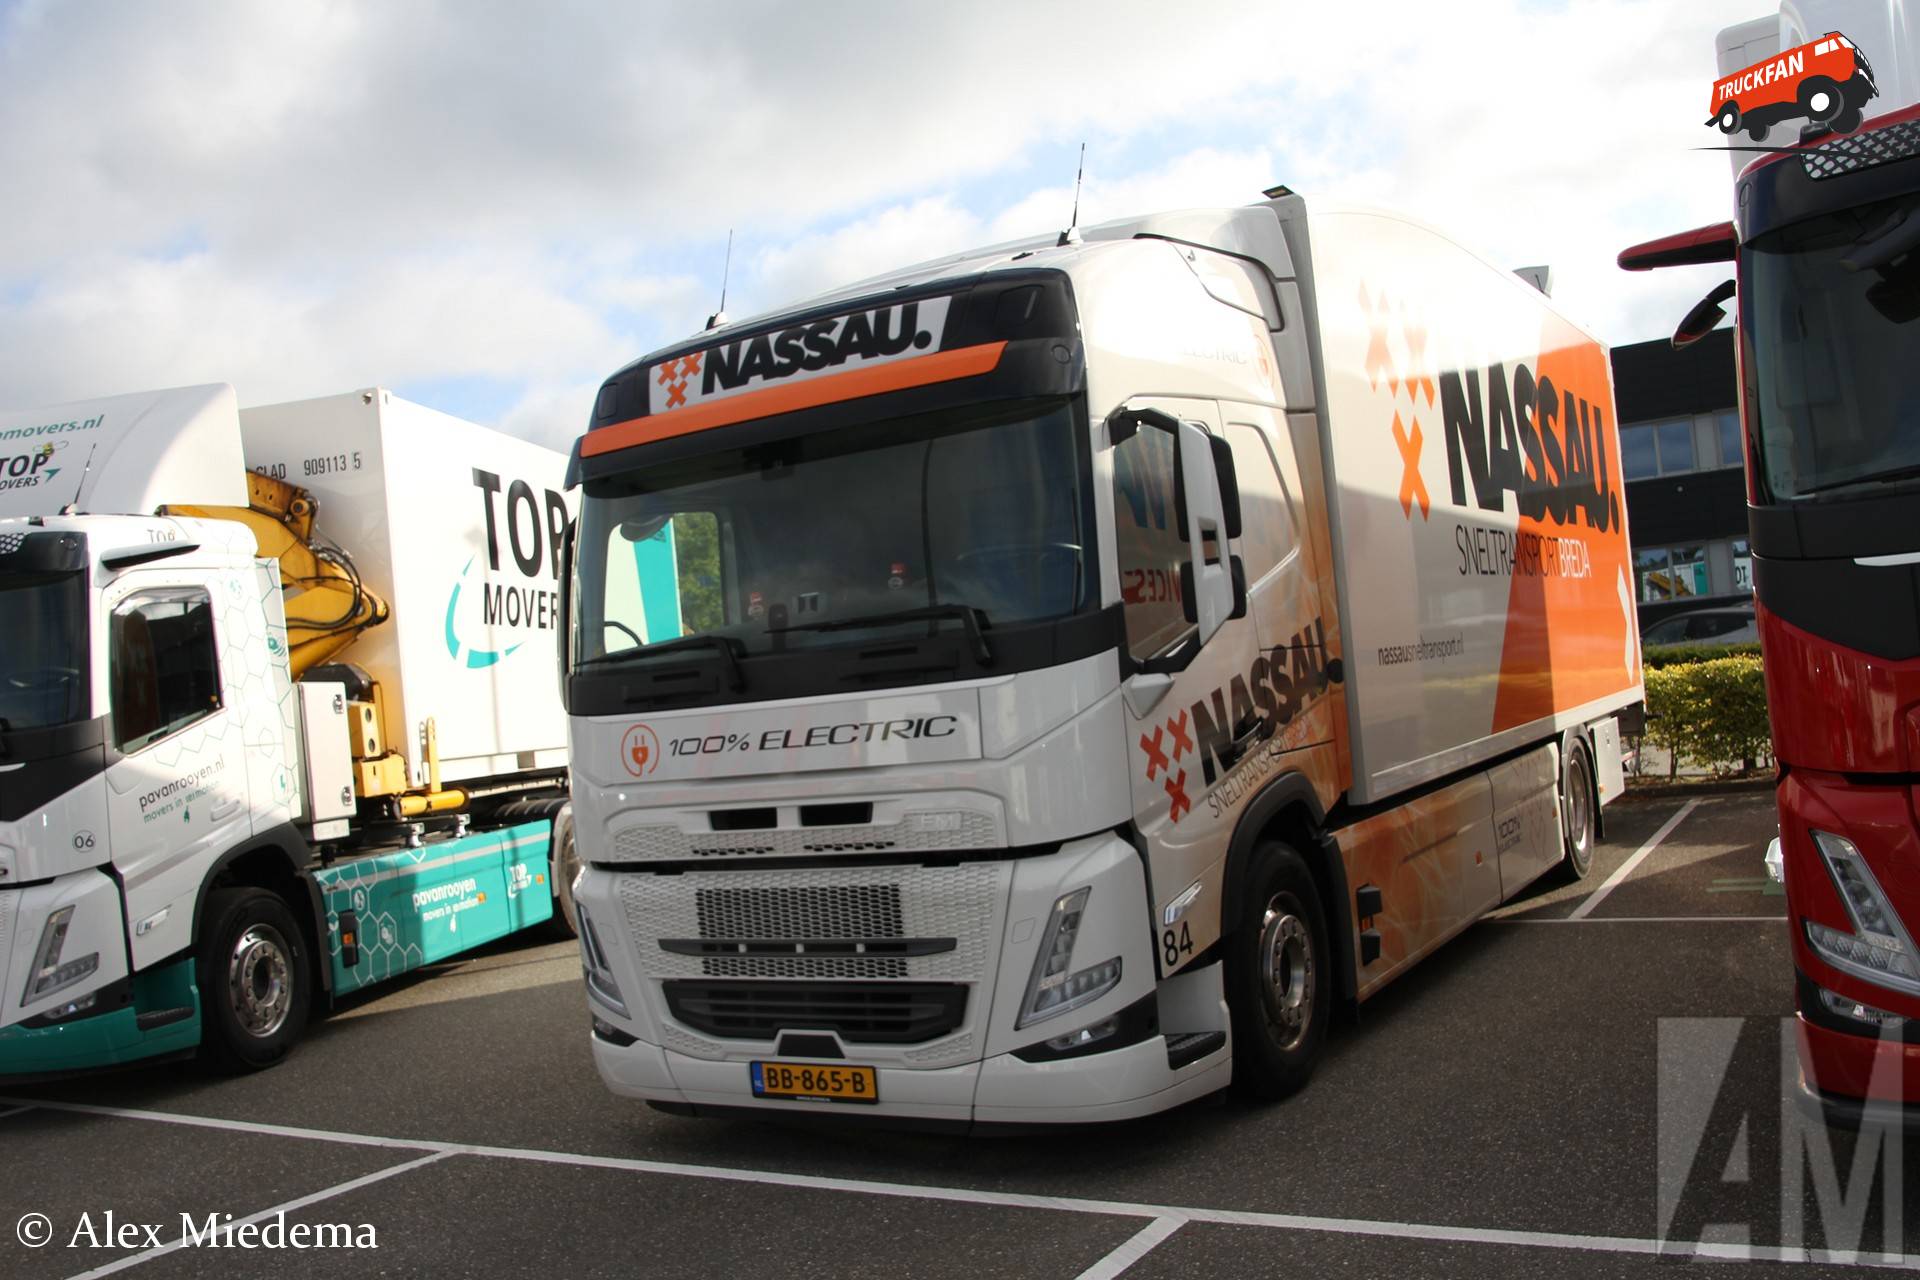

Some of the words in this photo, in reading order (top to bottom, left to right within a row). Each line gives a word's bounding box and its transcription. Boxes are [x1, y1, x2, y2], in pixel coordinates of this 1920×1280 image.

[304, 454, 347, 476] 909113
[353, 452, 361, 470] 5
[472, 467, 570, 580] TOP
[1378, 632, 1464, 665] nassausneltransport.nl
[669, 733, 749, 756] 100%
[758, 715, 957, 751] ELECTRIC
[139, 754, 225, 813] pavanrooyen.nl
[74, 834, 95, 849] 06
[412, 878, 477, 913] pavanrooyen
[1163, 920, 1193, 967] 84
[767, 1067, 865, 1093] BB-865-B
